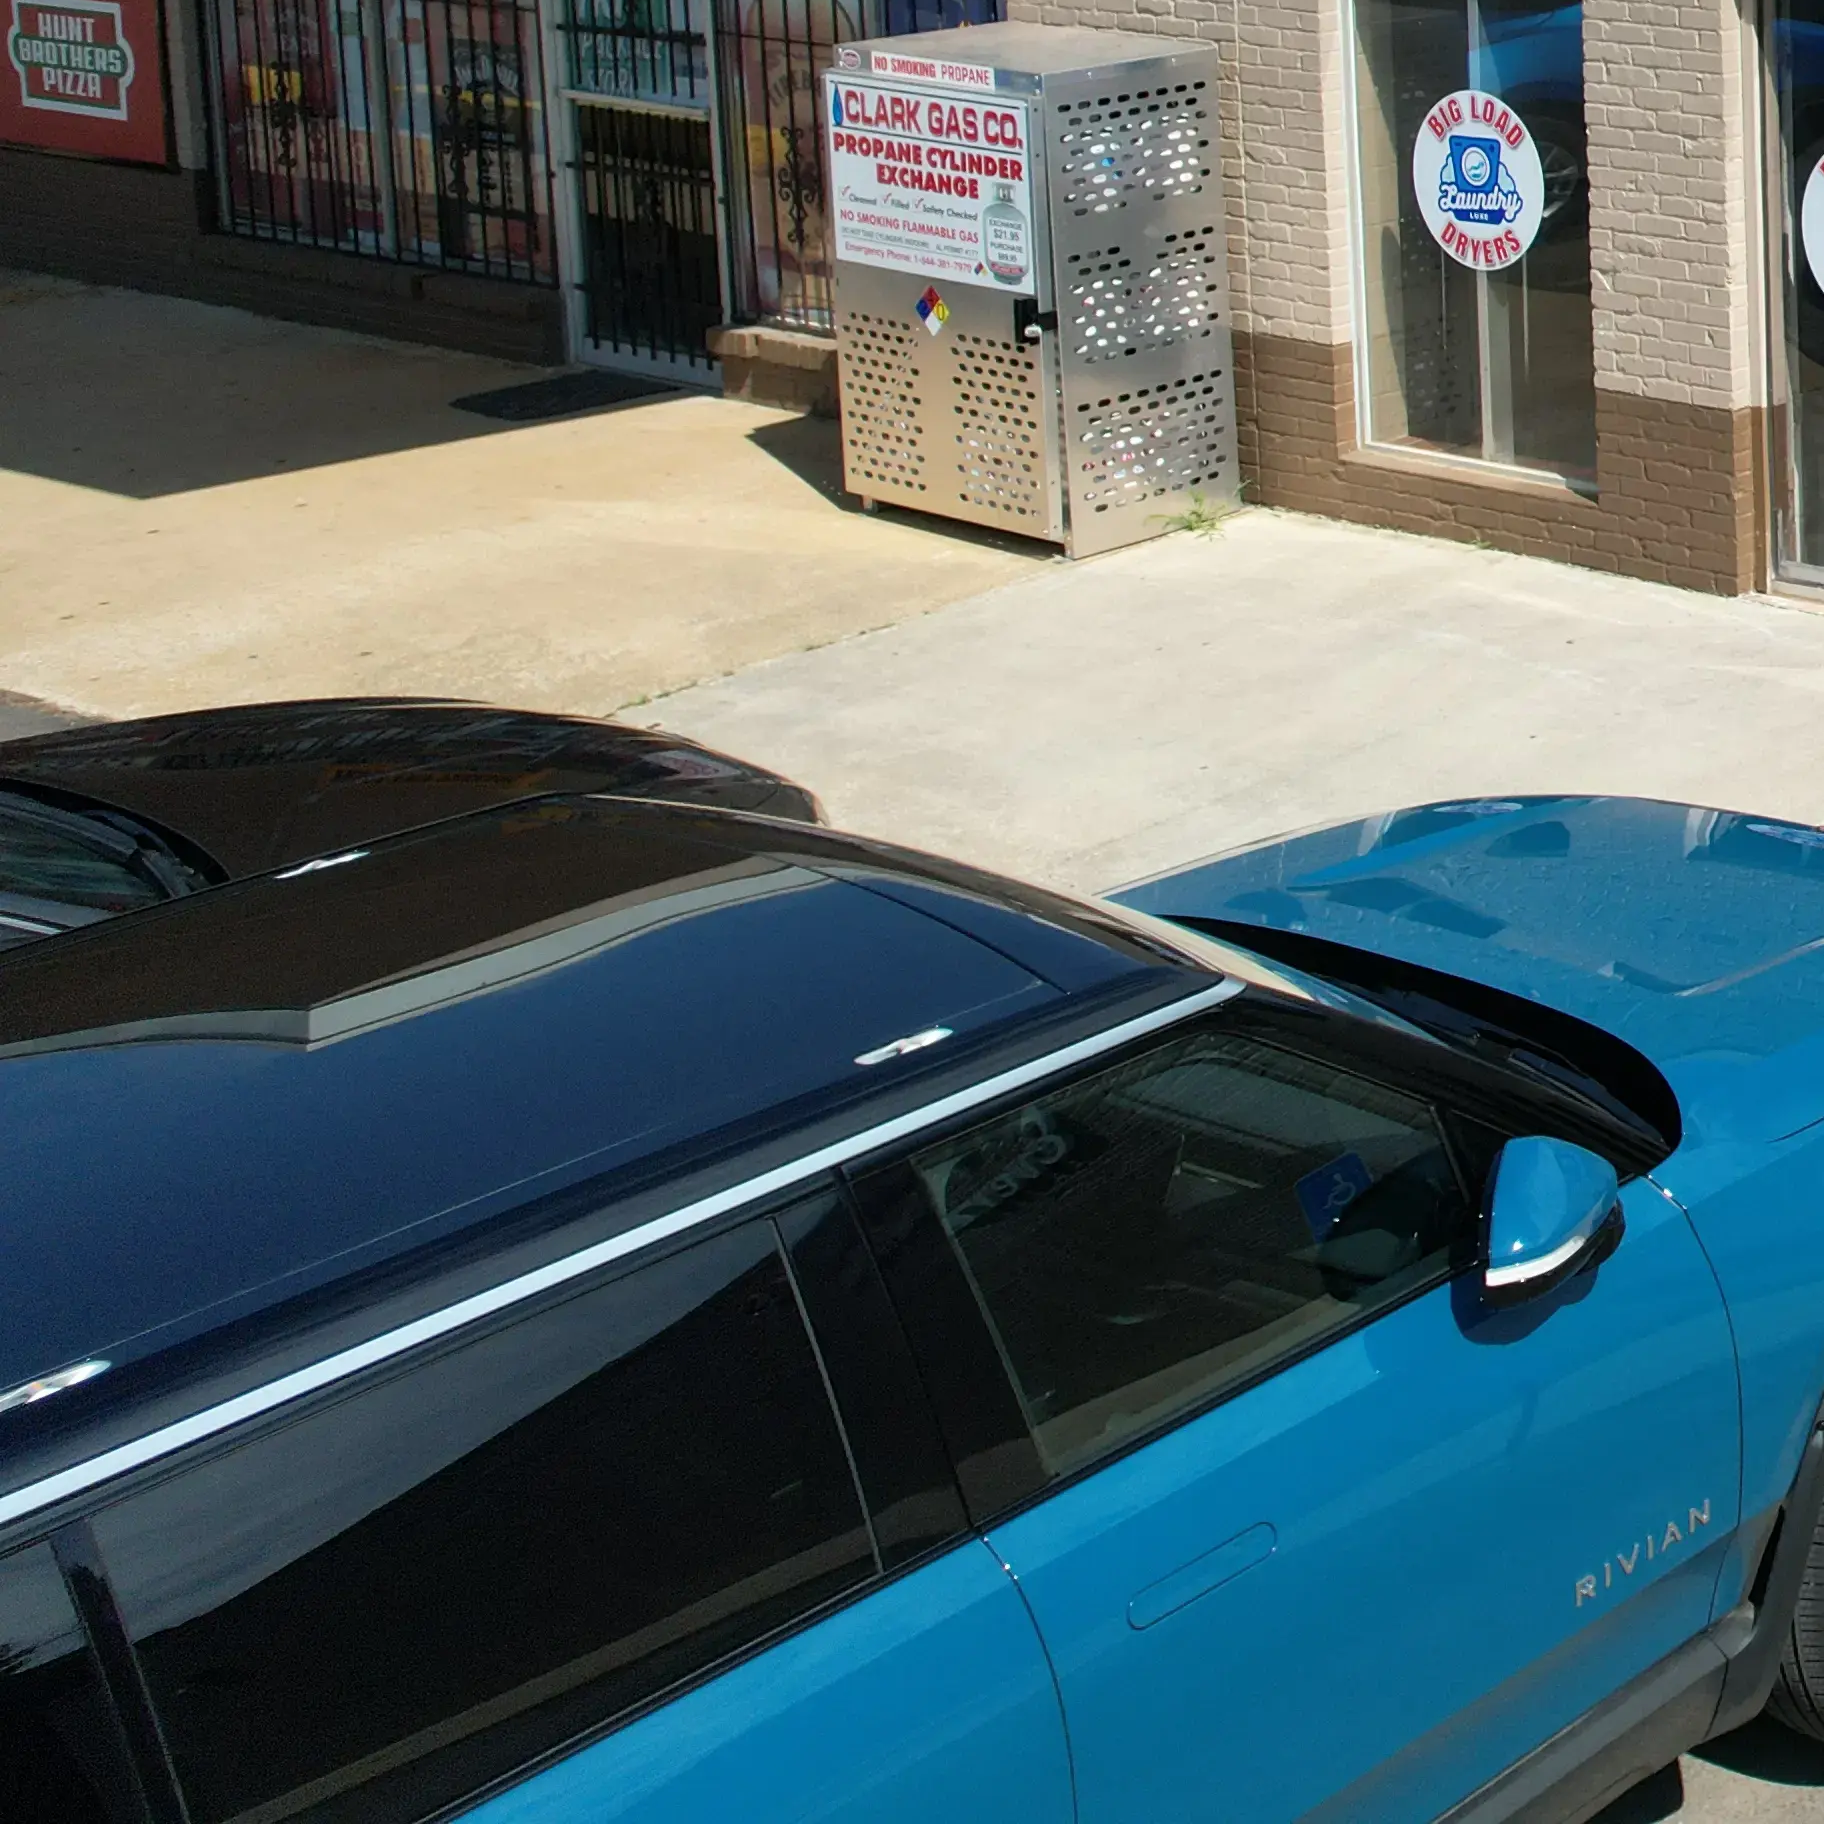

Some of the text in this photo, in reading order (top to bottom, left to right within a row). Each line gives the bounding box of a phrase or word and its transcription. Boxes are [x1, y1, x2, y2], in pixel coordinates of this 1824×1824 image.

[37, 12, 96, 43] HUNT
[18, 38, 122, 73] BROTHERS
[873, 55, 888, 71] NO
[891, 58, 937, 78] SMOKING
[941, 64, 991, 86] PROPANE
[42, 66, 102, 98] PIZZA
[844, 89, 1024, 150] CLARK GAS CO.
[1427, 94, 1524, 147] BIG LOAD
[833, 131, 1024, 181] PROPANE CYLINDER
[876, 163, 980, 200] EXCHANGE
[922, 204, 945, 217] Safety
[946, 208, 979, 222] Checked
[1440, 184, 1522, 221] Laundry
[840, 209, 979, 244] NO SMOKING FLAMMABLE GAS
[1441, 221, 1521, 265] DRYERS
[845, 241, 885, 259] Emergency
[1575, 1498, 1711, 1608] RIVIAN
